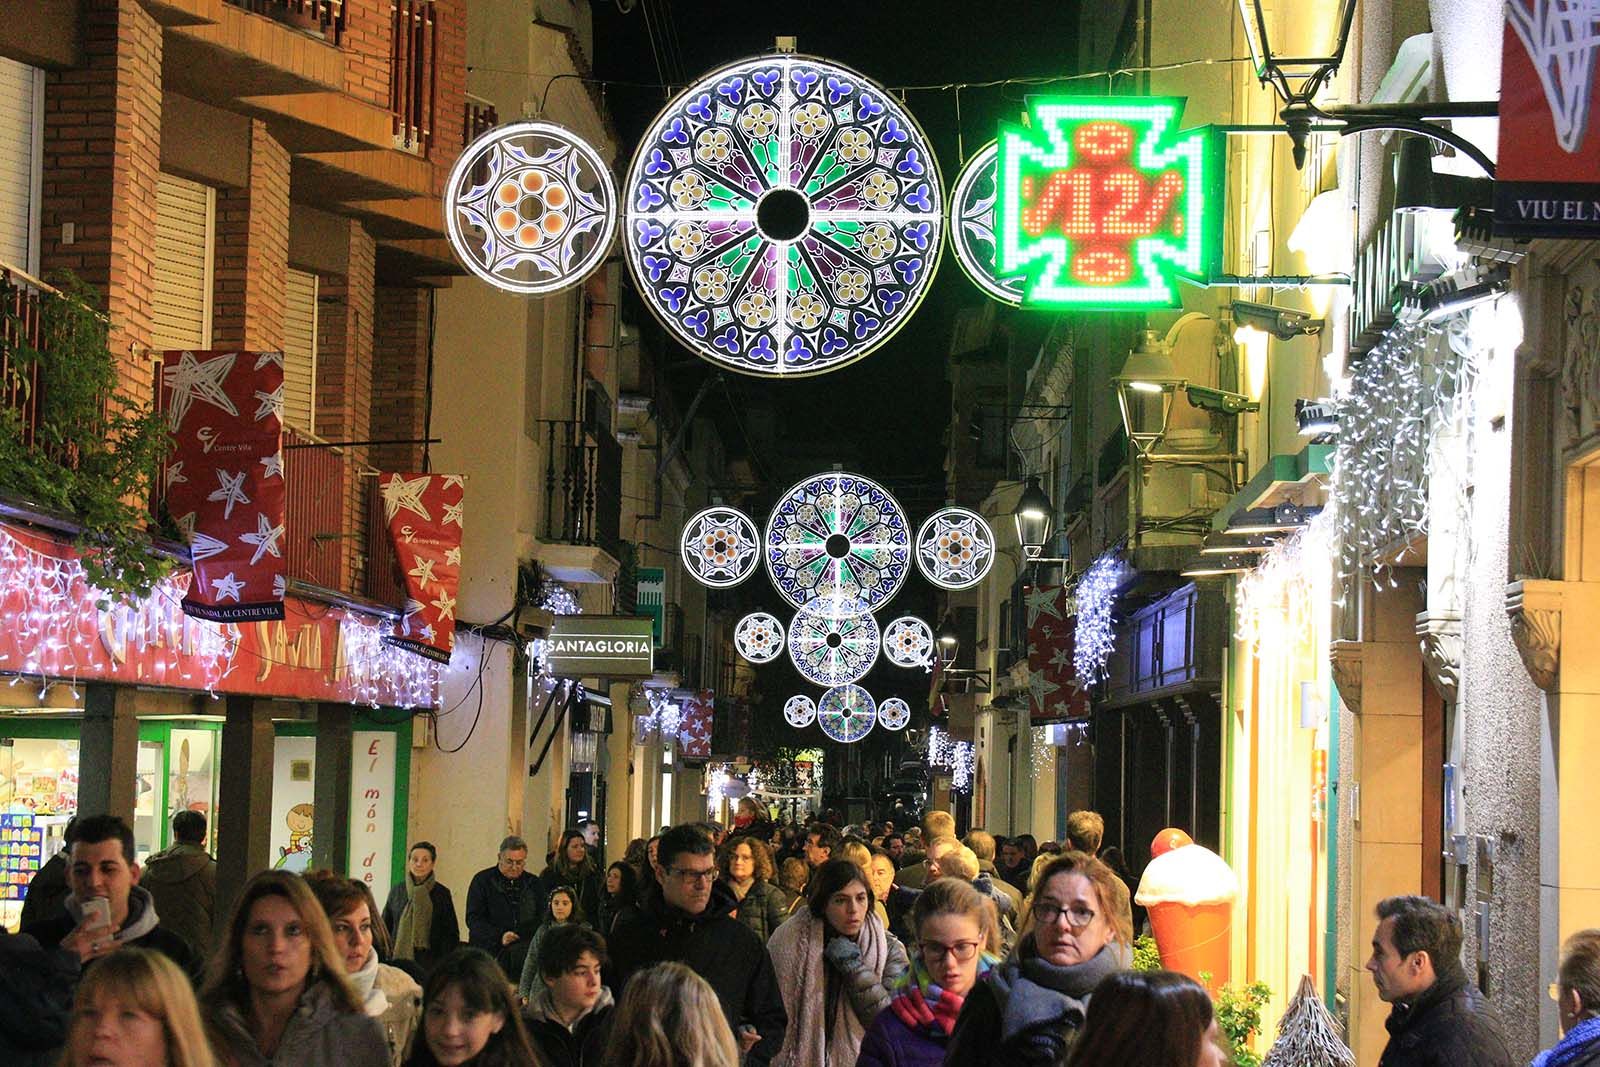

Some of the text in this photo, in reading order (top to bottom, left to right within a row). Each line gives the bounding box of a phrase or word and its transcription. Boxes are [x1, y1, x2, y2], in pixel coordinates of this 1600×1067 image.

[1516, 199, 1558, 220] VIU
[1562, 200, 1588, 221] EL
[213, 443, 252, 451] Centre Vila
[201, 608, 221, 617] NADAL
[222, 609, 231, 617] AL
[232, 606, 260, 617] CENTRE
[261, 605, 280, 615] VILA
[548, 640, 650, 654] SANTAGLORIA
[362, 739, 381, 882] El món de
